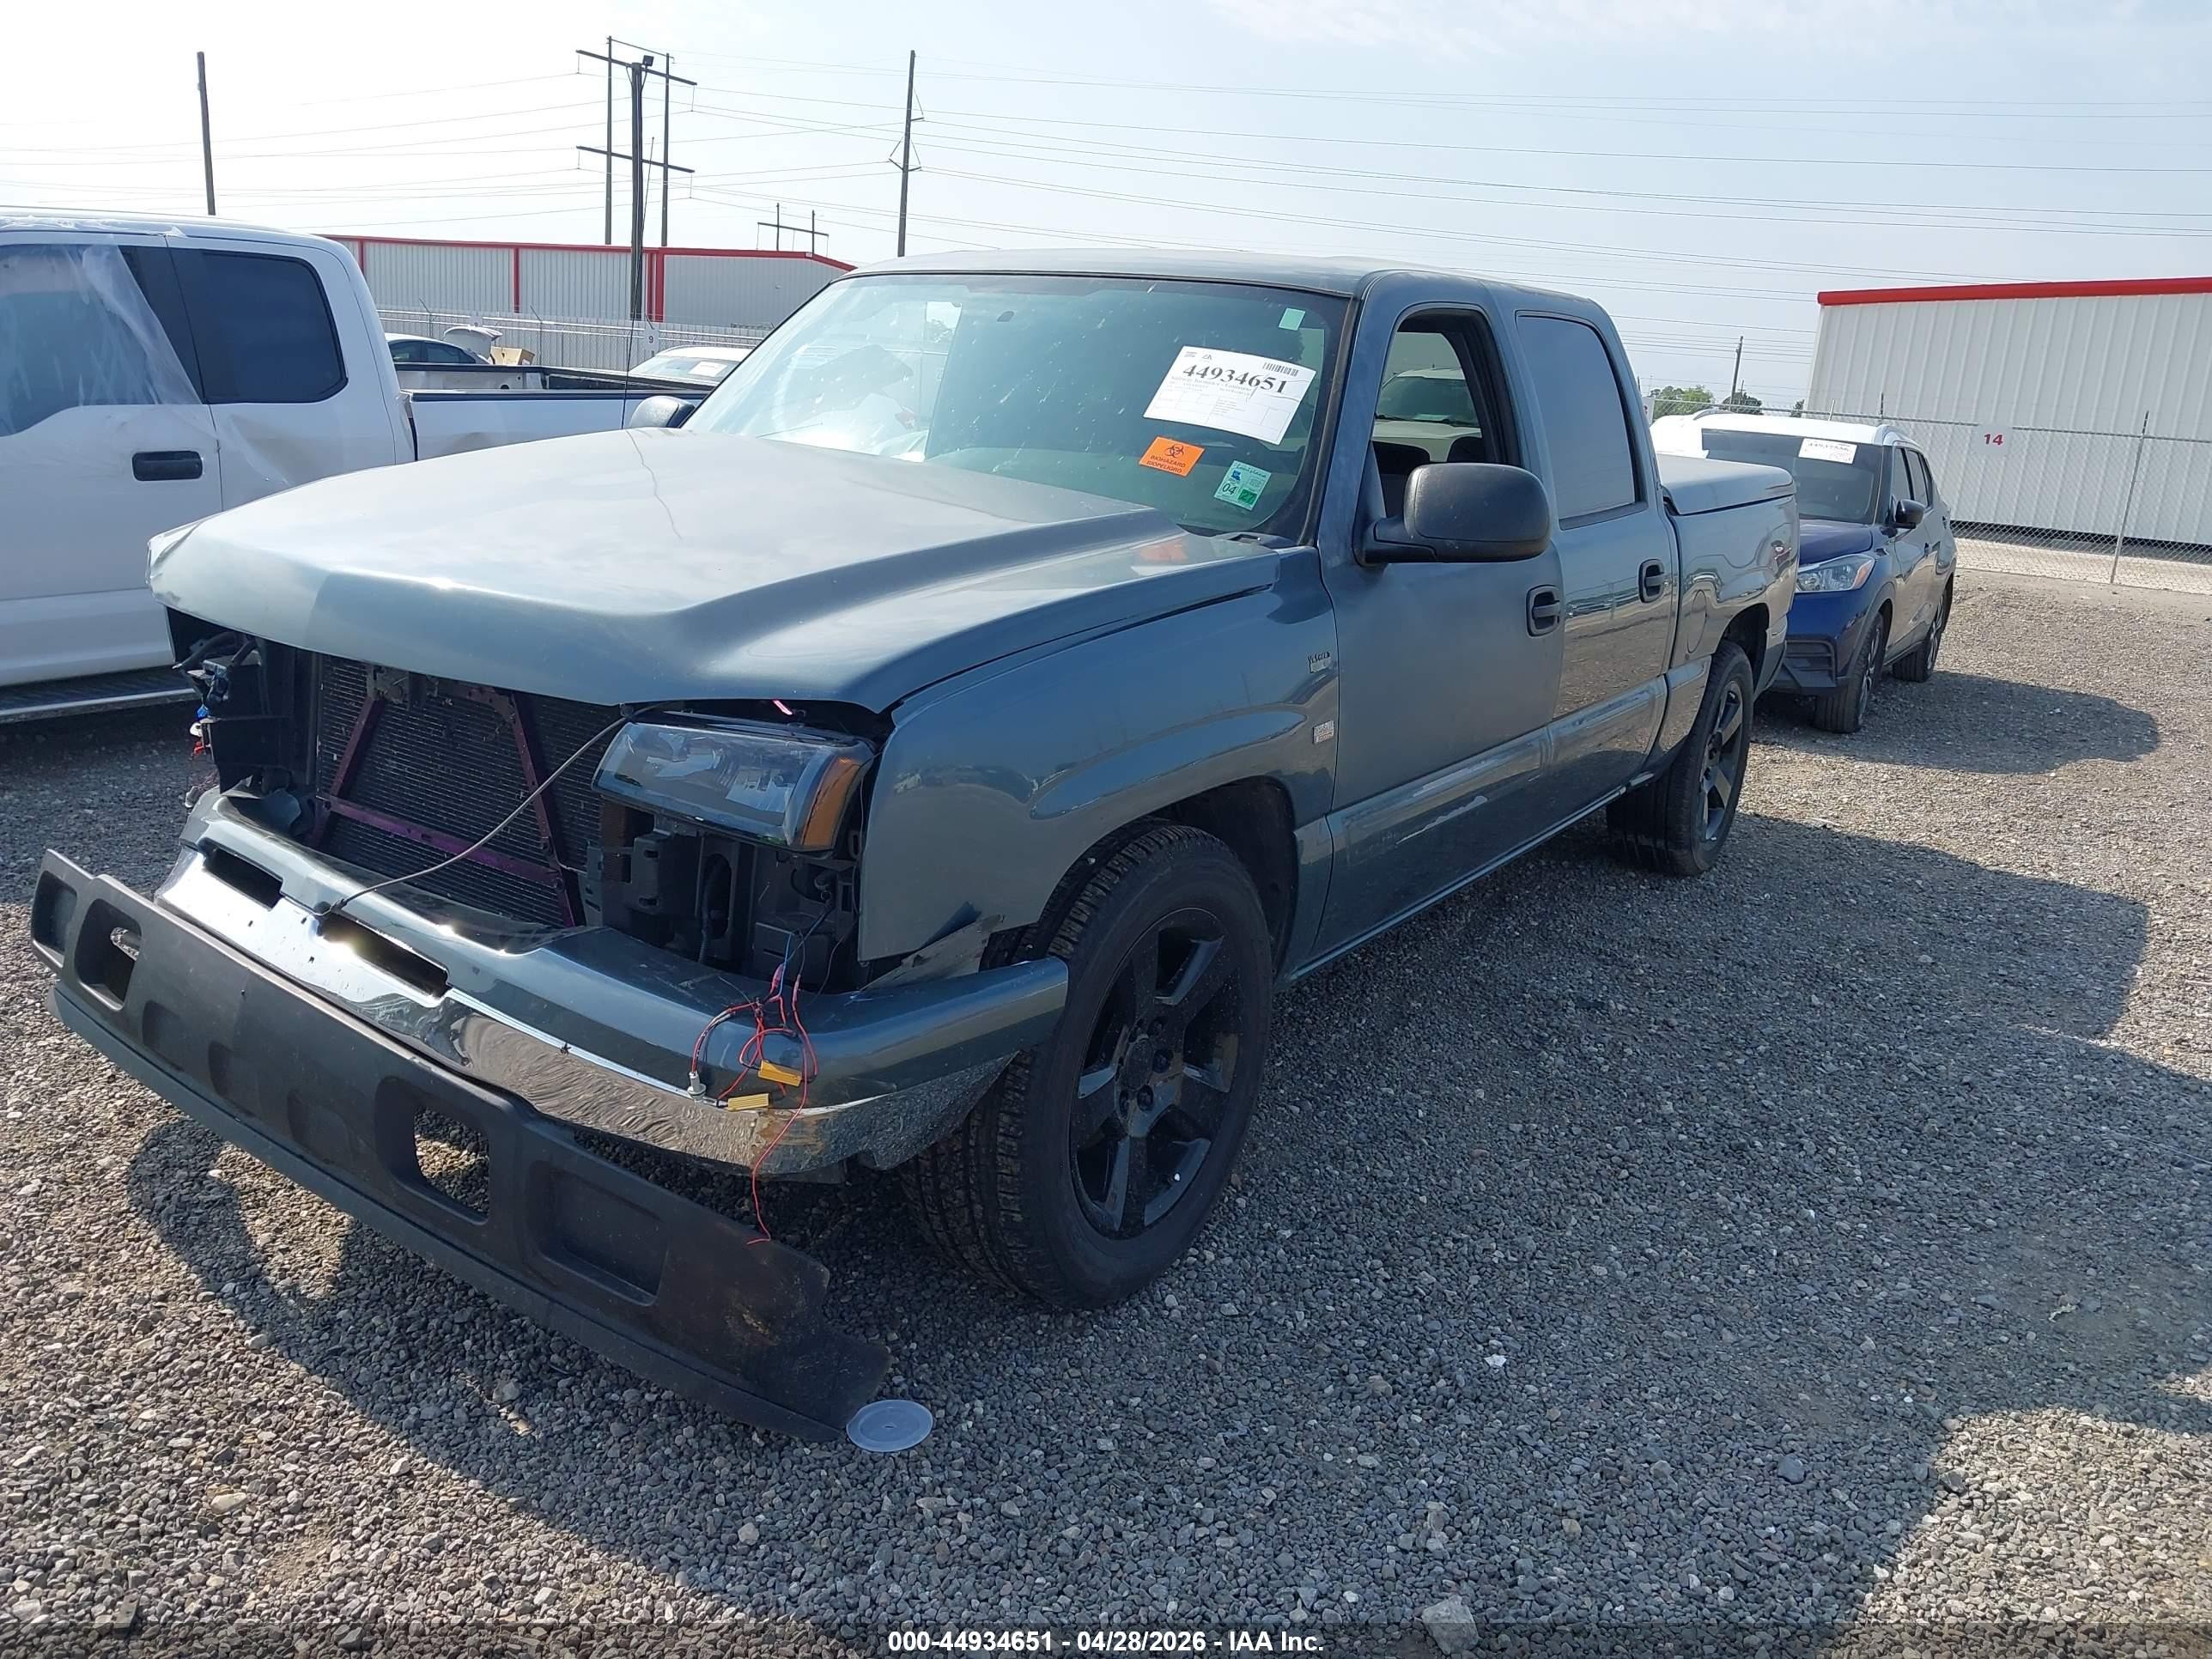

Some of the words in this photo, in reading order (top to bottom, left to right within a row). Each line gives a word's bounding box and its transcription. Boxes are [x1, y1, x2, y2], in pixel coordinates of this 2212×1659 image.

[1182, 364, 1288, 394] 44934651
[1984, 434, 2003, 446] 14
[1146, 460, 1182, 473] BIOPELIGRO
[1150, 454, 1186, 468] BIOHAZARD
[1222, 483, 1237, 495] 04
[1240, 489, 1257, 505] 27
